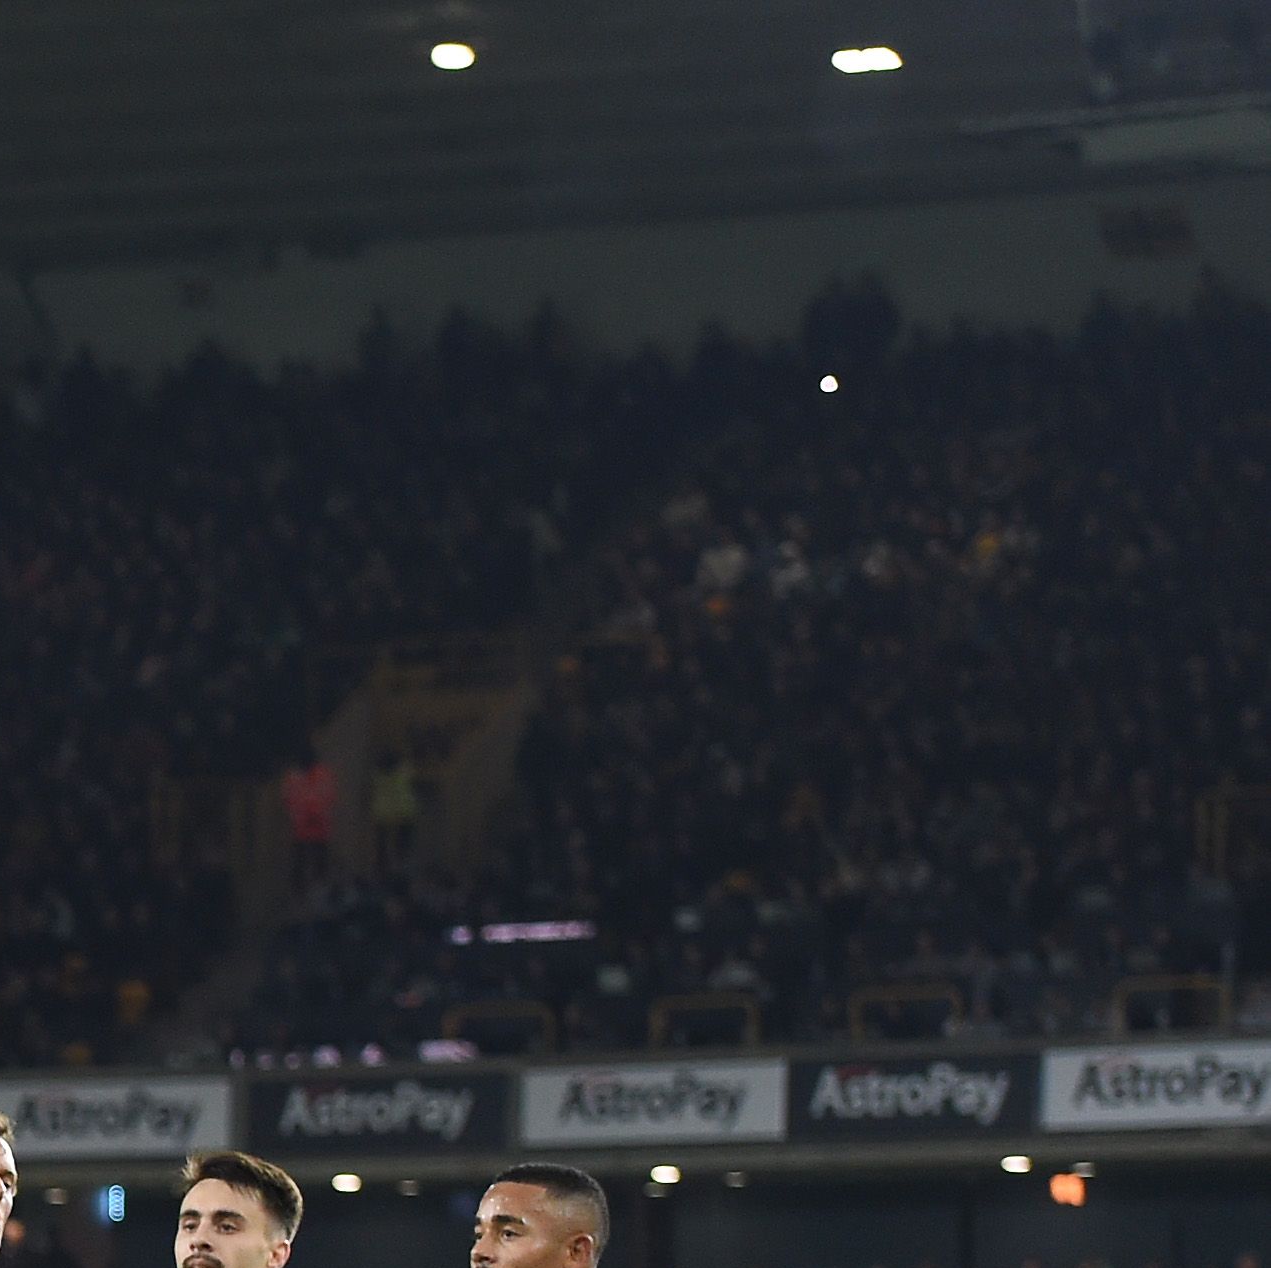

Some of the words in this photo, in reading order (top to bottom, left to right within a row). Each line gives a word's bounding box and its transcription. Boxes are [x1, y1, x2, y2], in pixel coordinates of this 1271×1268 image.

[278, 1080, 476, 1139] AstroPay
[558, 1070, 750, 1132] AstroPay
[810, 1062, 1008, 1124] AstroPay
